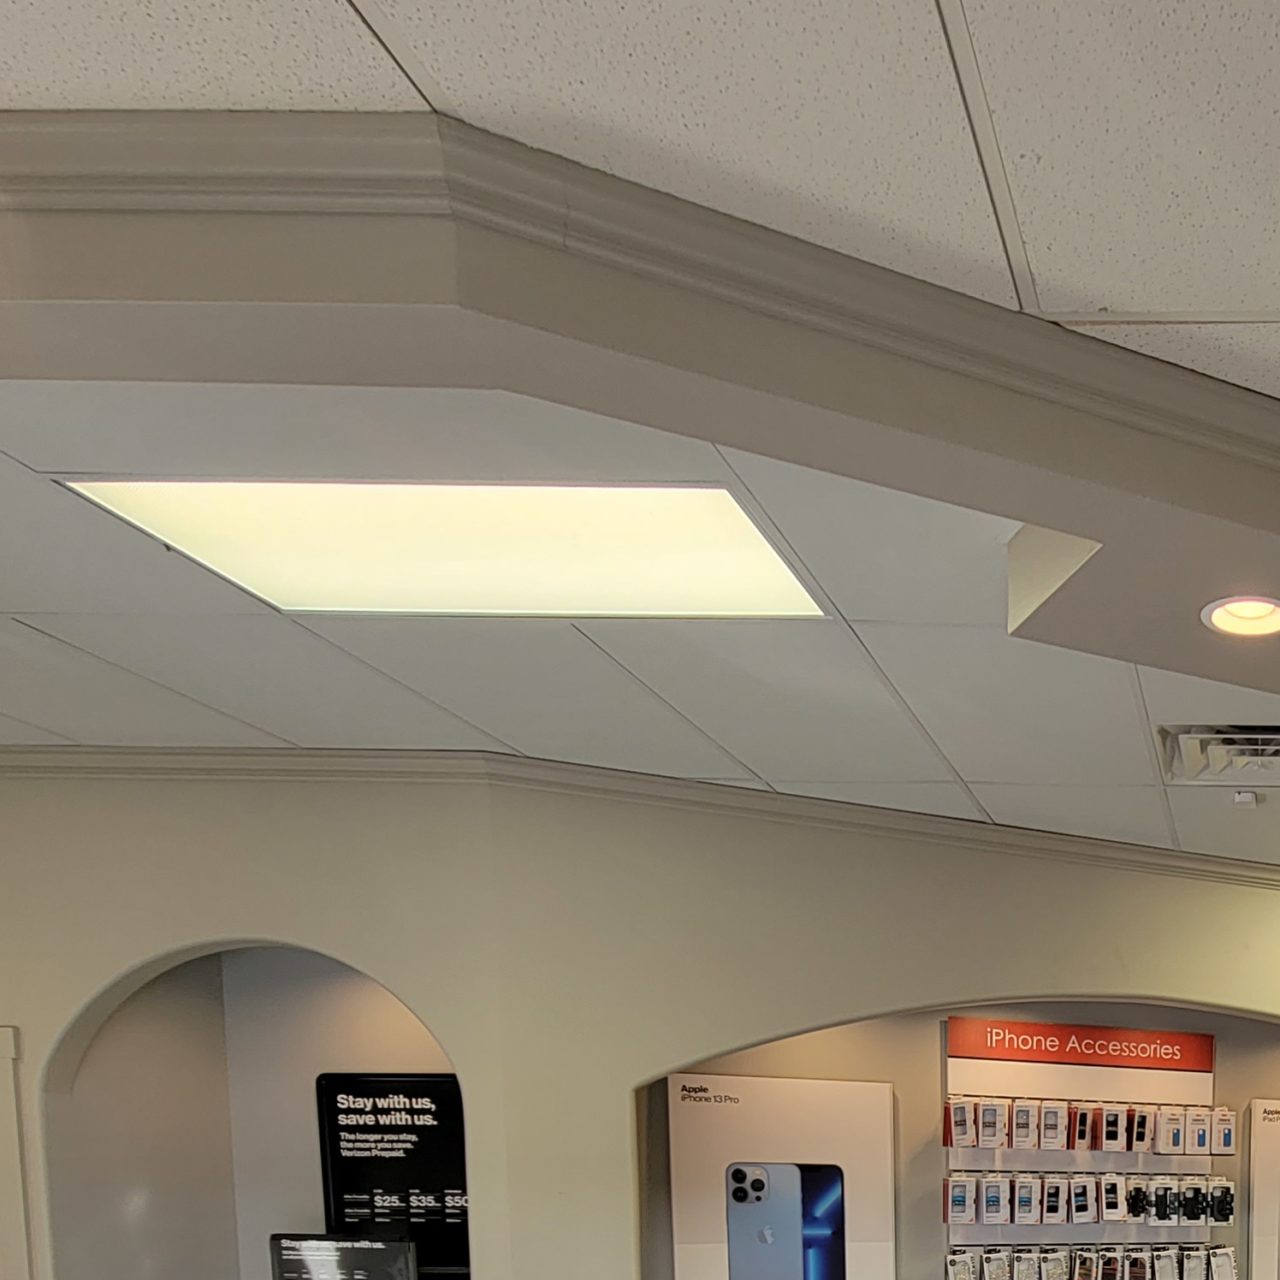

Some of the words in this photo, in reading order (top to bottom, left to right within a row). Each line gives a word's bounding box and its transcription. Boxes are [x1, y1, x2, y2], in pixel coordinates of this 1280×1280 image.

[986, 1028, 1059, 1052] iPhone
[1066, 1035, 1181, 1060] Accessories
[681, 1084, 709, 1094] Apple
[337, 1094, 373, 1111] Stay
[375, 1094, 410, 1108] with
[411, 1098, 436, 1111] us,
[713, 1095, 723, 1103] 13
[724, 1095, 740, 1104] Pro
[337, 1114, 376, 1125] save
[377, 1111, 412, 1125] with
[413, 1114, 438, 1125] us.
[339, 1132, 355, 1140] The
[356, 1132, 381, 1141] longer
[340, 1141, 354, 1149] the
[374, 1195, 399, 1207] $25
[410, 1195, 435, 1207] $35
